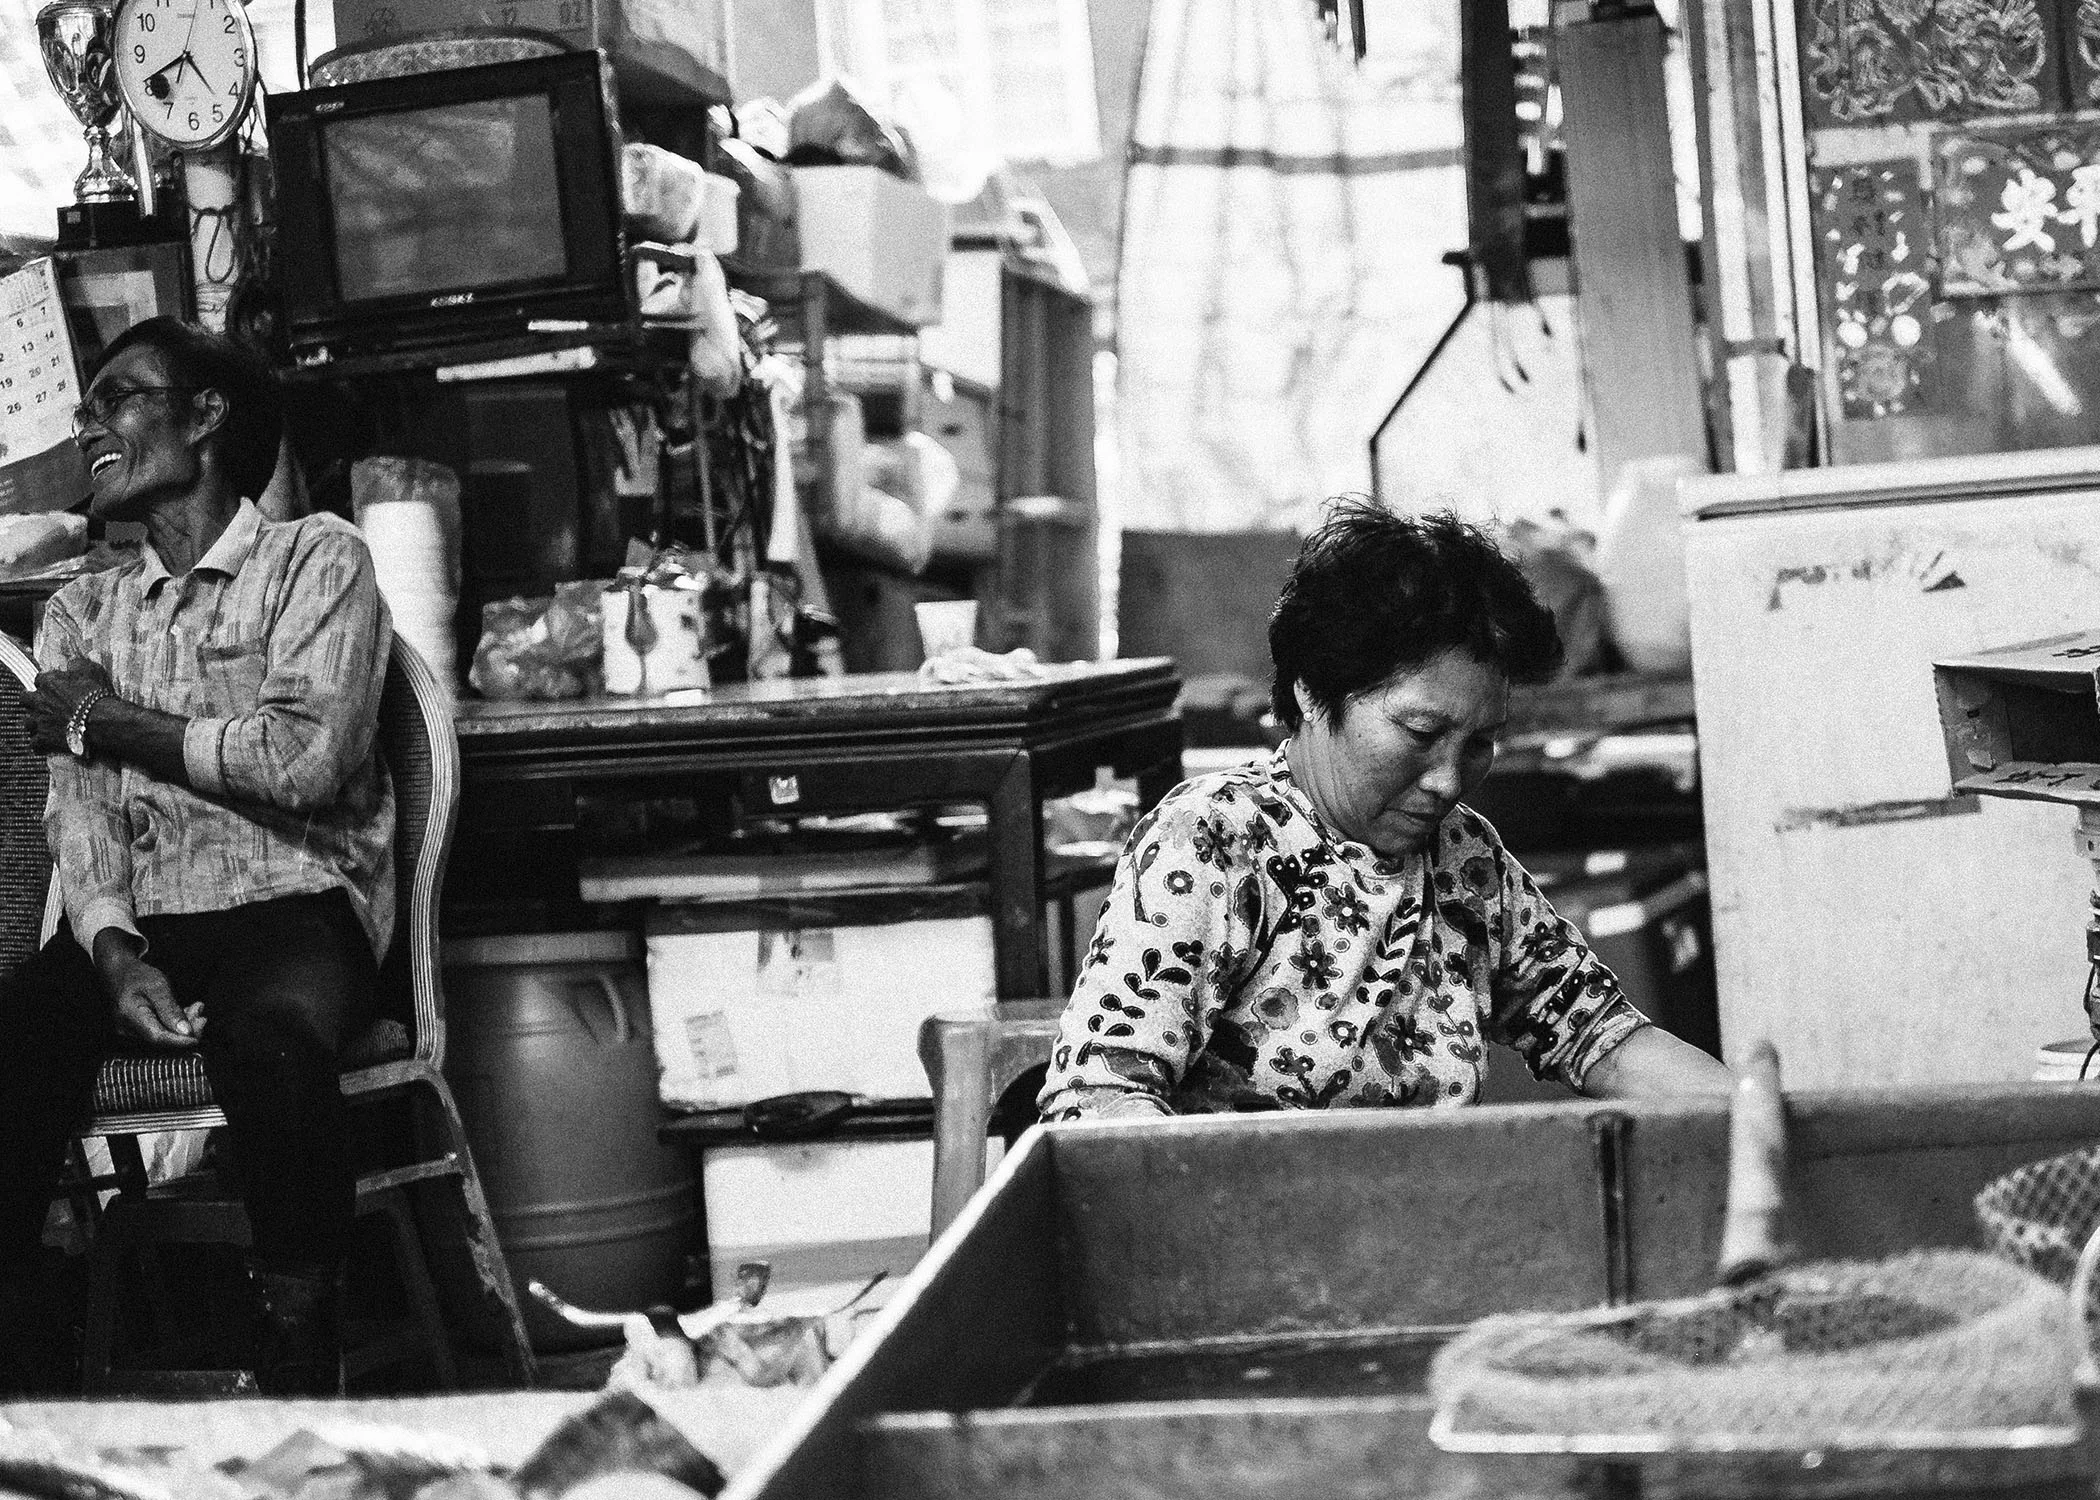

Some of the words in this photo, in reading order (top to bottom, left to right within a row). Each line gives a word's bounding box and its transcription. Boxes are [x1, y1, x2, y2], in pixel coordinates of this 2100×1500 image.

[137, 13, 156, 32] 10
[223, 15, 236, 34] 2
[134, 45, 146, 64] 9
[233, 47, 245, 68] 3
[228, 81, 241, 100] 4
[163, 102, 174, 120] 7
[212, 104, 224, 123] 5
[188, 112, 200, 131] 6
[16, 318, 24, 328] 6
[21, 341, 34, 354] 13
[45, 330, 55, 341] 14
[0, 377, 13, 389] 19
[28, 366, 42, 379] 20
[51, 355, 60, 368] 21
[7, 402, 22, 415] 26
[35, 391, 47, 404] 27
